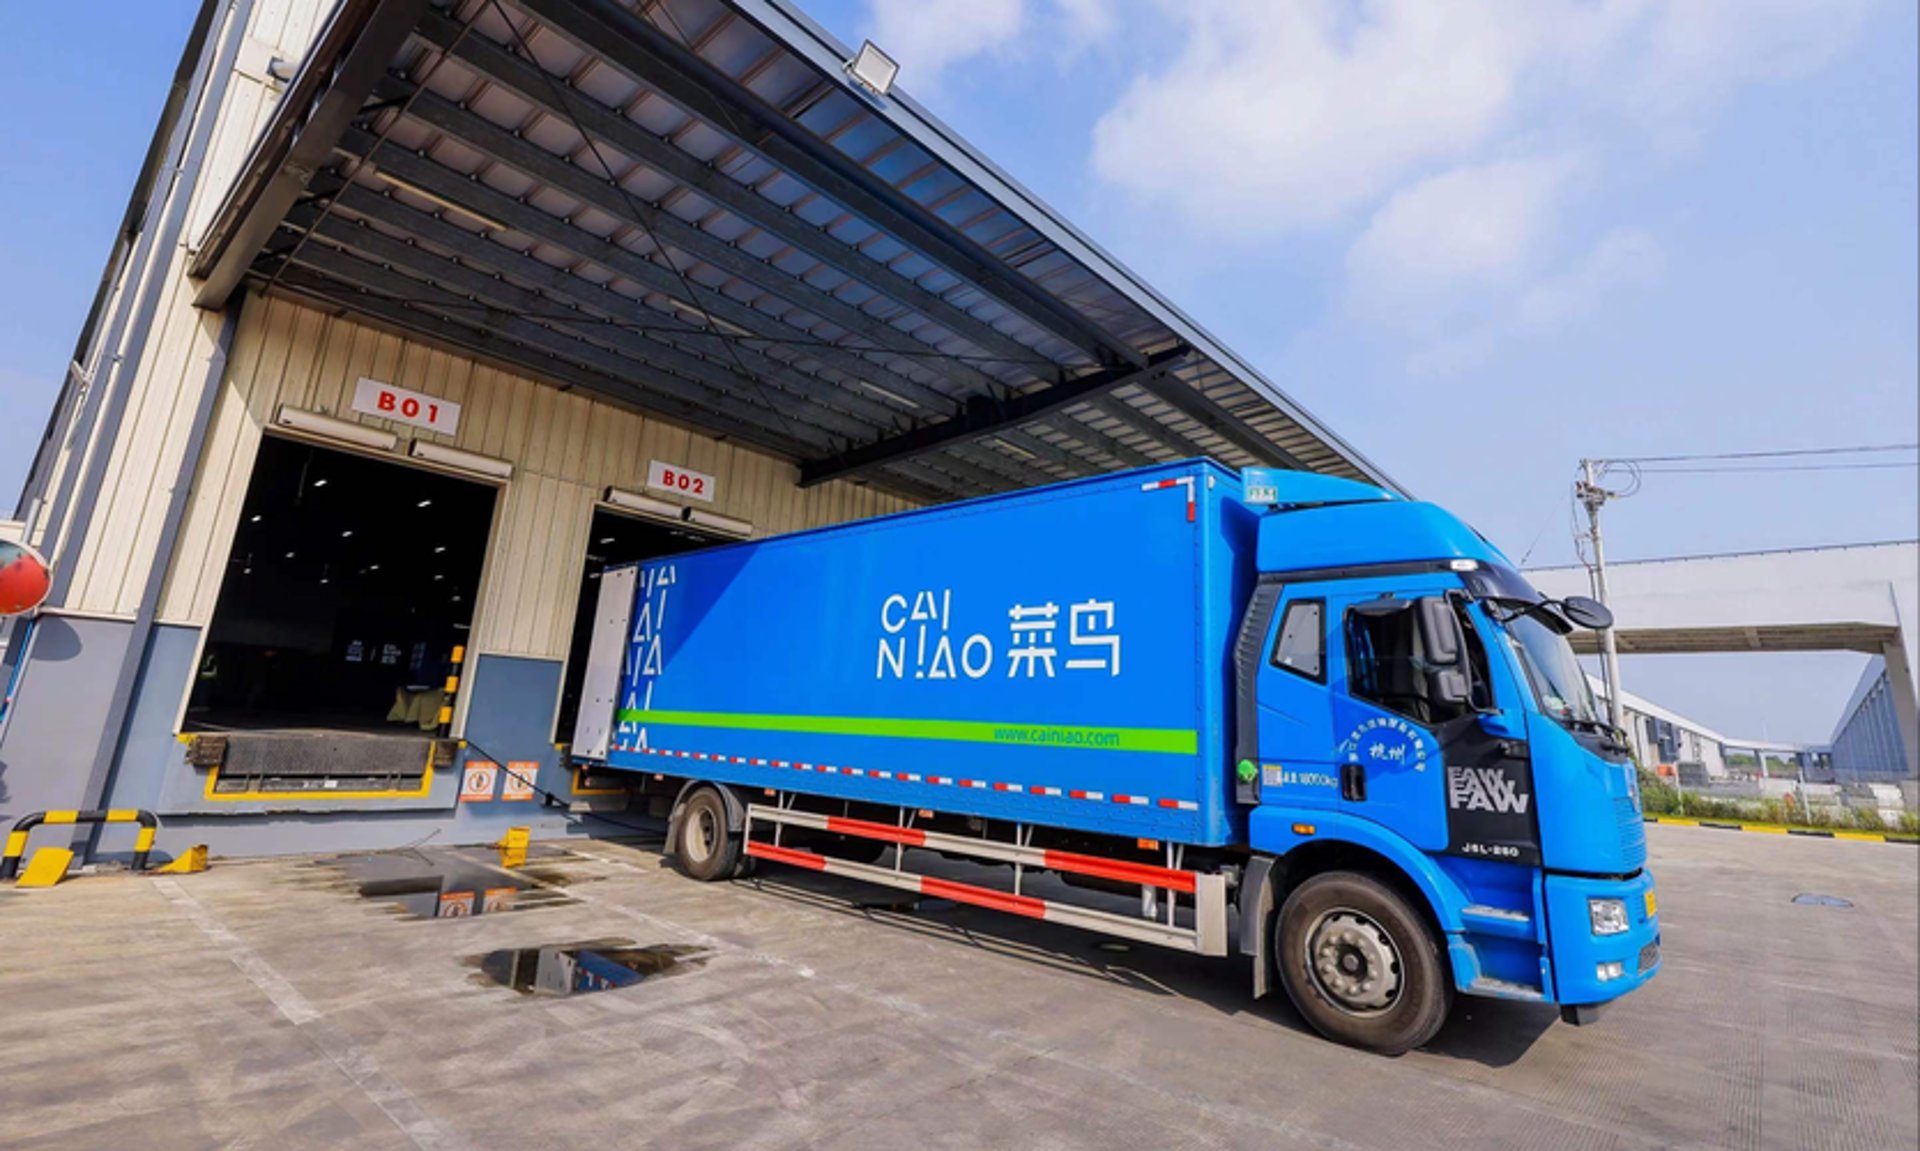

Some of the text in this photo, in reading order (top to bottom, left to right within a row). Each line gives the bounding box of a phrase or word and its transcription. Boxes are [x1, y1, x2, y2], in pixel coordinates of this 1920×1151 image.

[377, 390, 438, 423] B01
[663, 469, 704, 494] B02
[881, 589, 951, 634] CAI
[1007, 598, 1120, 678] 菜鸟
[993, 727, 1120, 747] www.cainiao.com
